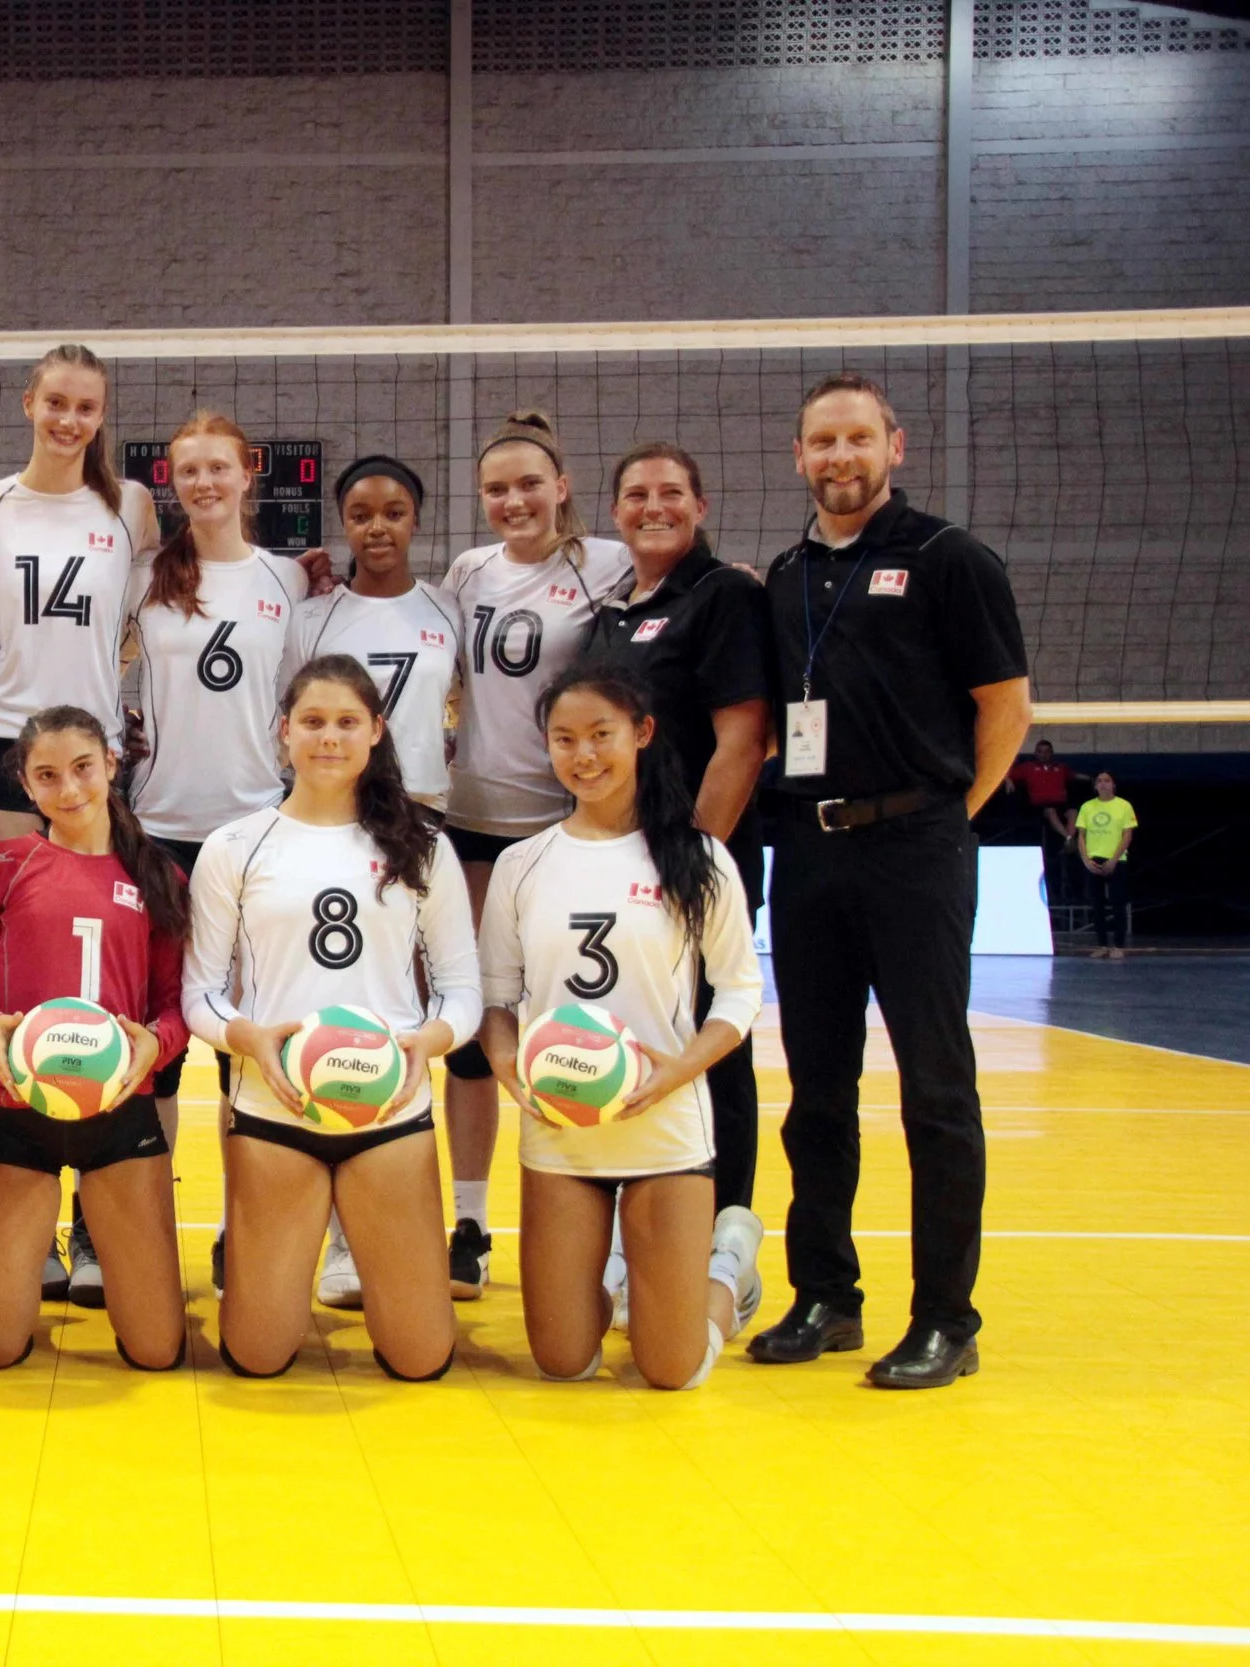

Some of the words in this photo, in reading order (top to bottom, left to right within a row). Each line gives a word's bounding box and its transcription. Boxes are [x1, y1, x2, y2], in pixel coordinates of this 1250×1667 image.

[274, 444, 319, 456] VISITOR
[300, 459, 316, 482] 0
[273, 487, 302, 496] BONUS
[282, 503, 310, 513] FOULS
[287, 537, 306, 546] WON
[15, 556, 91, 627] 14
[473, 604, 543, 678] 10
[197, 620, 243, 692] 6
[367, 652, 419, 721] 7
[308, 887, 363, 969] 8
[72, 917, 102, 1002] 1
[564, 912, 619, 999] 3
[46, 1032, 98, 1048] molten
[327, 1057, 379, 1075] molten
[545, 1052, 598, 1076] molten
